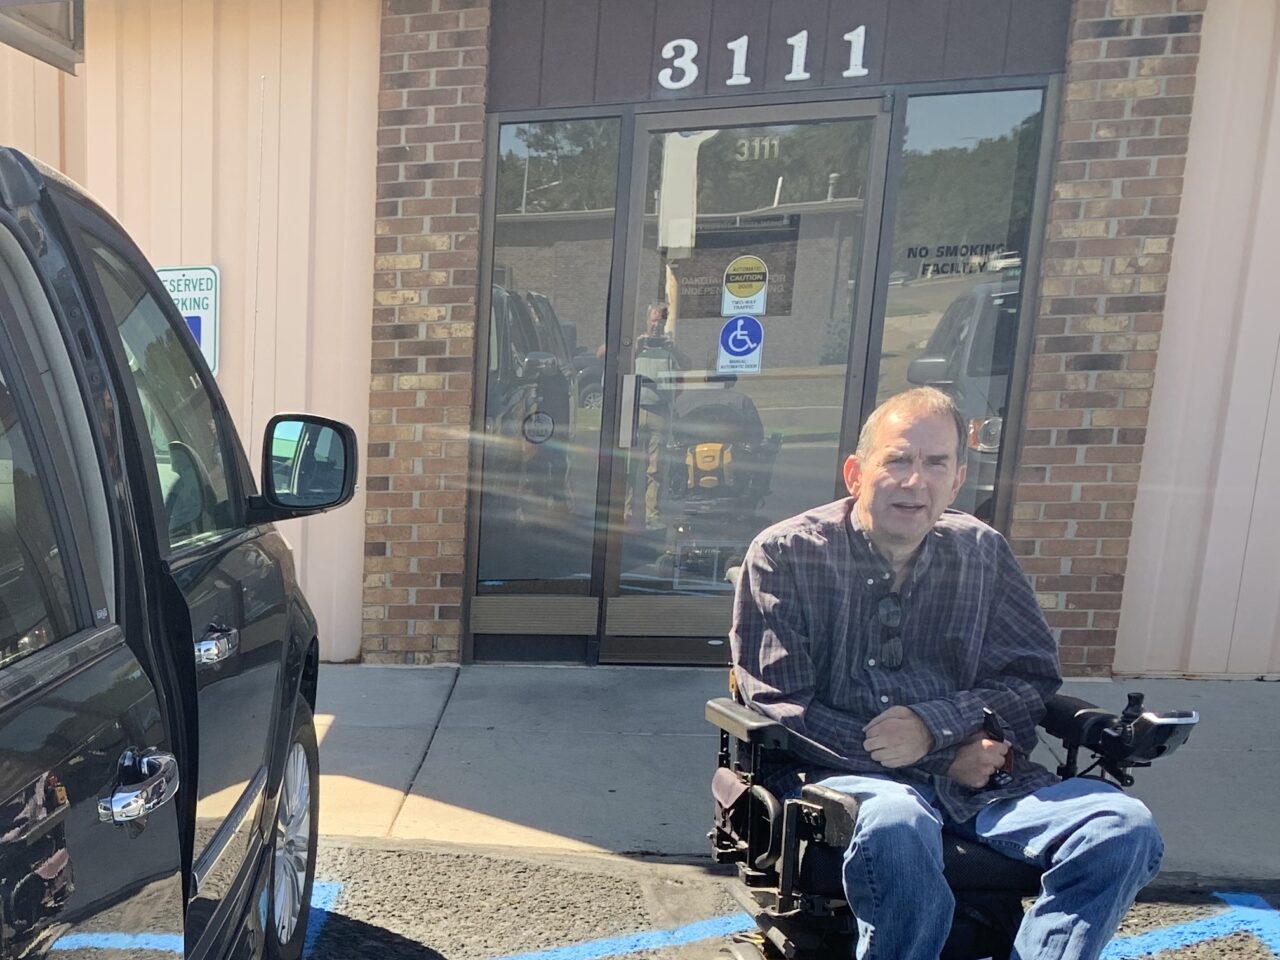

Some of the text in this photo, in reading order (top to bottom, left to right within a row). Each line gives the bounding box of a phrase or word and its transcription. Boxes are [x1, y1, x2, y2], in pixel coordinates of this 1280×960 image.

[658, 24, 869, 90] 3111
[735, 136, 780, 162] 3111
[907, 243, 1005, 258] NO SMOKING
[921, 262, 987, 275] FACILITY
[162, 278, 214, 293] SERVED
[681, 275, 718, 284] DAKOTA
[681, 287, 721, 296] INDEPEN
[174, 297, 209, 311] RKING
